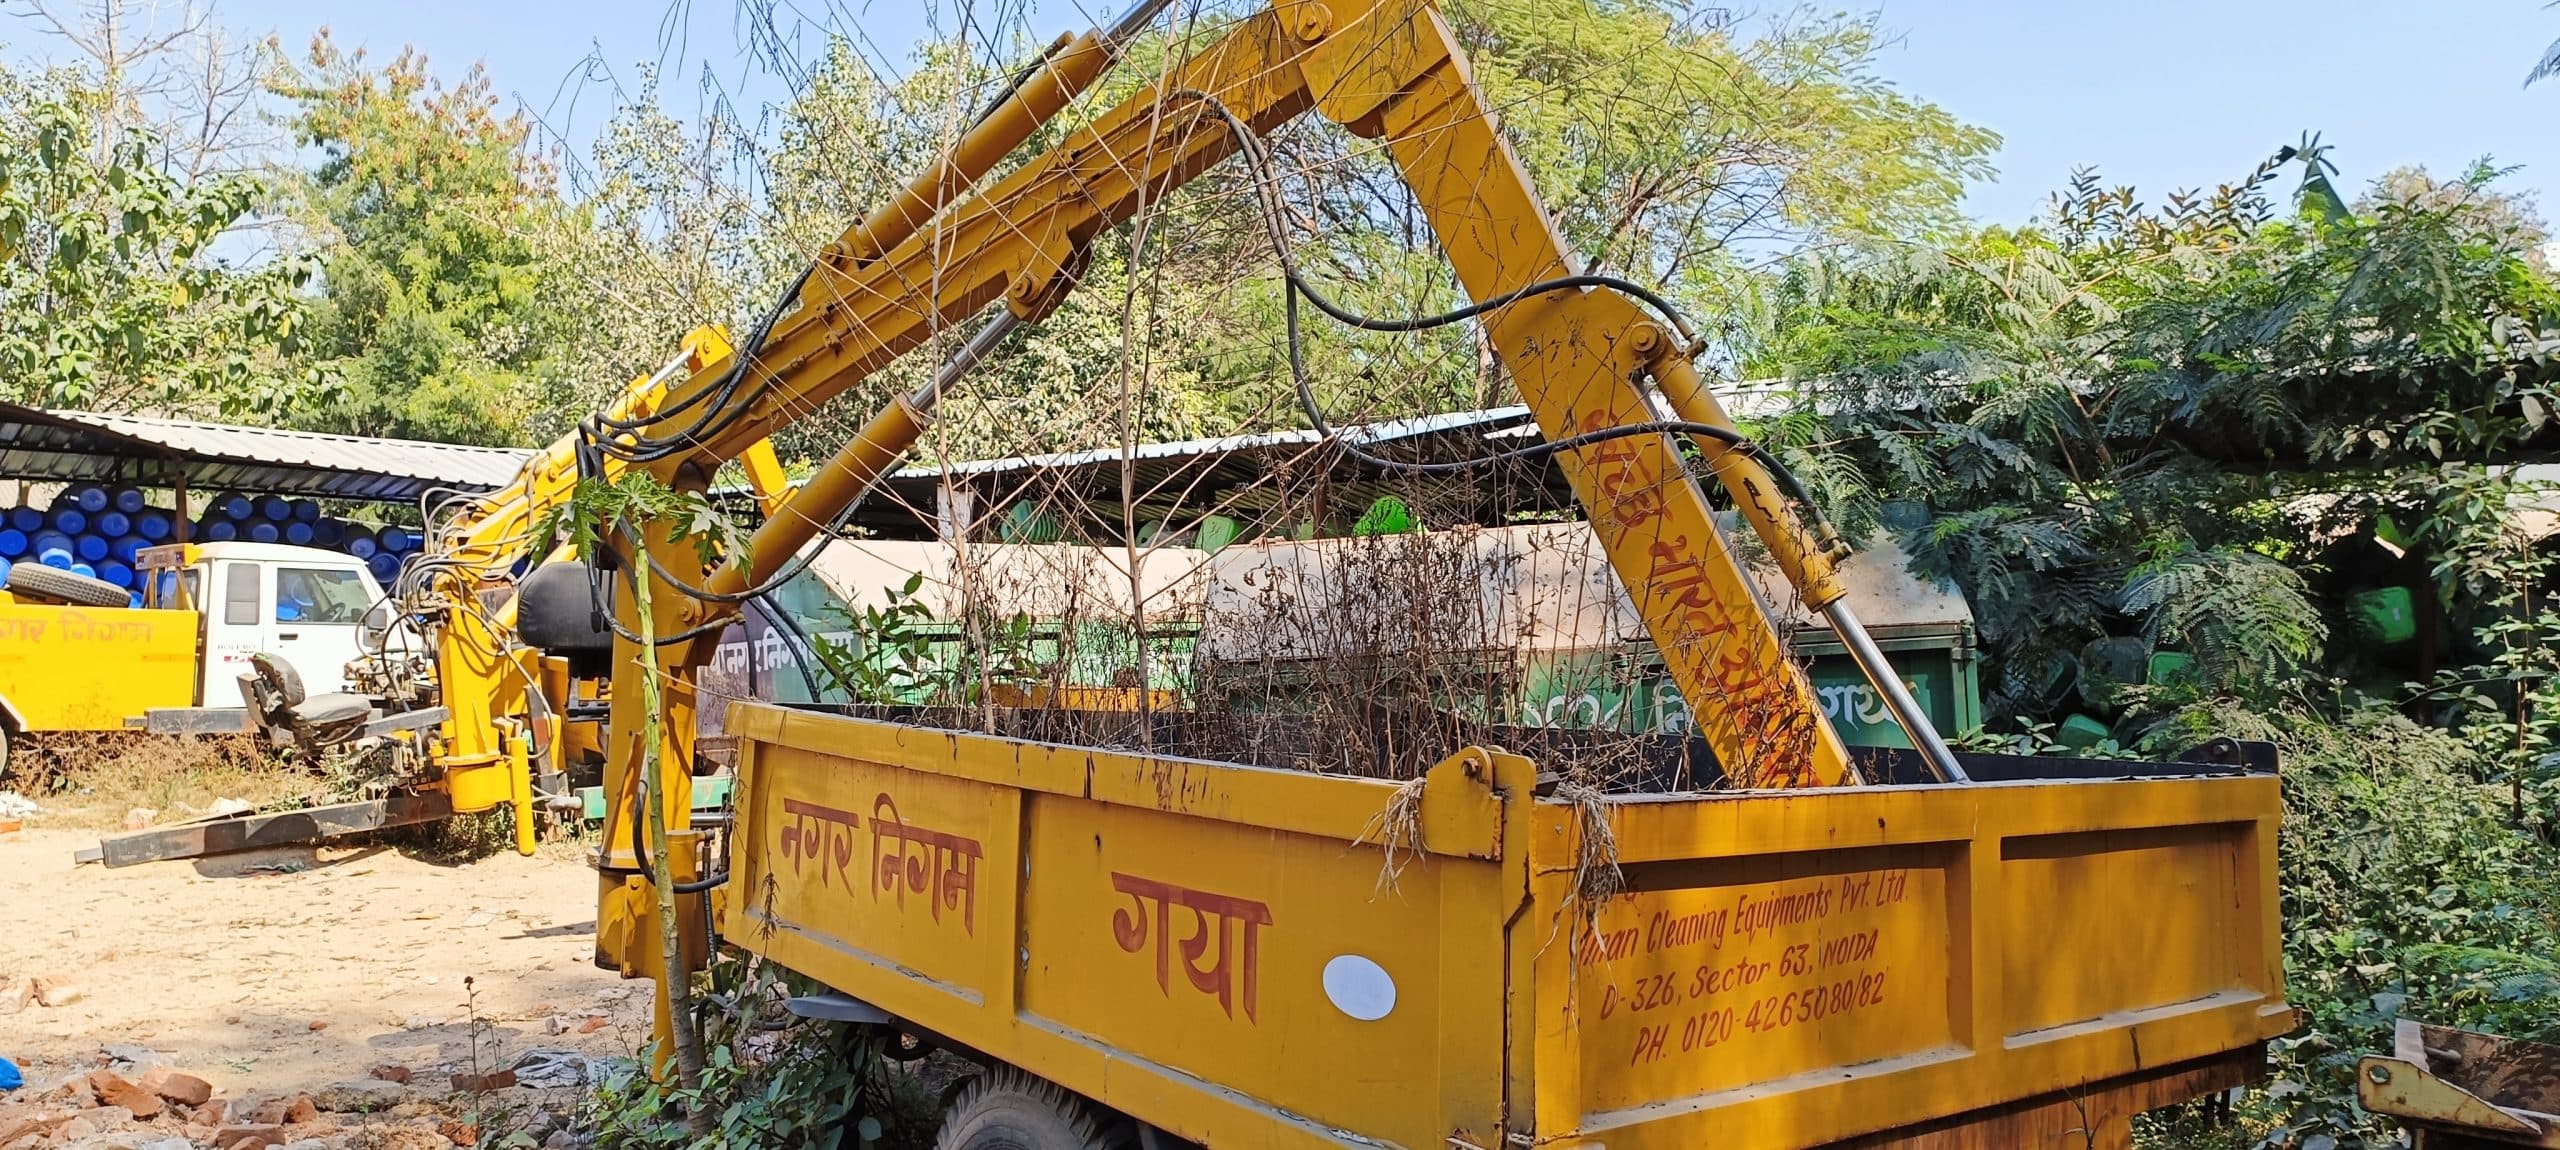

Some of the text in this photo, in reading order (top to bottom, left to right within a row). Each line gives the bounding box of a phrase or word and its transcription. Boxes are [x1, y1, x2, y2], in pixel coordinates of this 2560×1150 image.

[0, 619, 48, 644] गर
[781, 792, 983, 938] नगर निगम
[1111, 871, 1273, 1026] गया
[1646, 904, 1728, 954] Cleaning
[1734, 881, 1833, 945] Equipments
[1689, 956, 1771, 999] Sector
[1780, 943, 1813, 978] 63,
[1822, 928, 1879, 969] NOIDA
[1631, 1023, 1669, 1068] PH.
